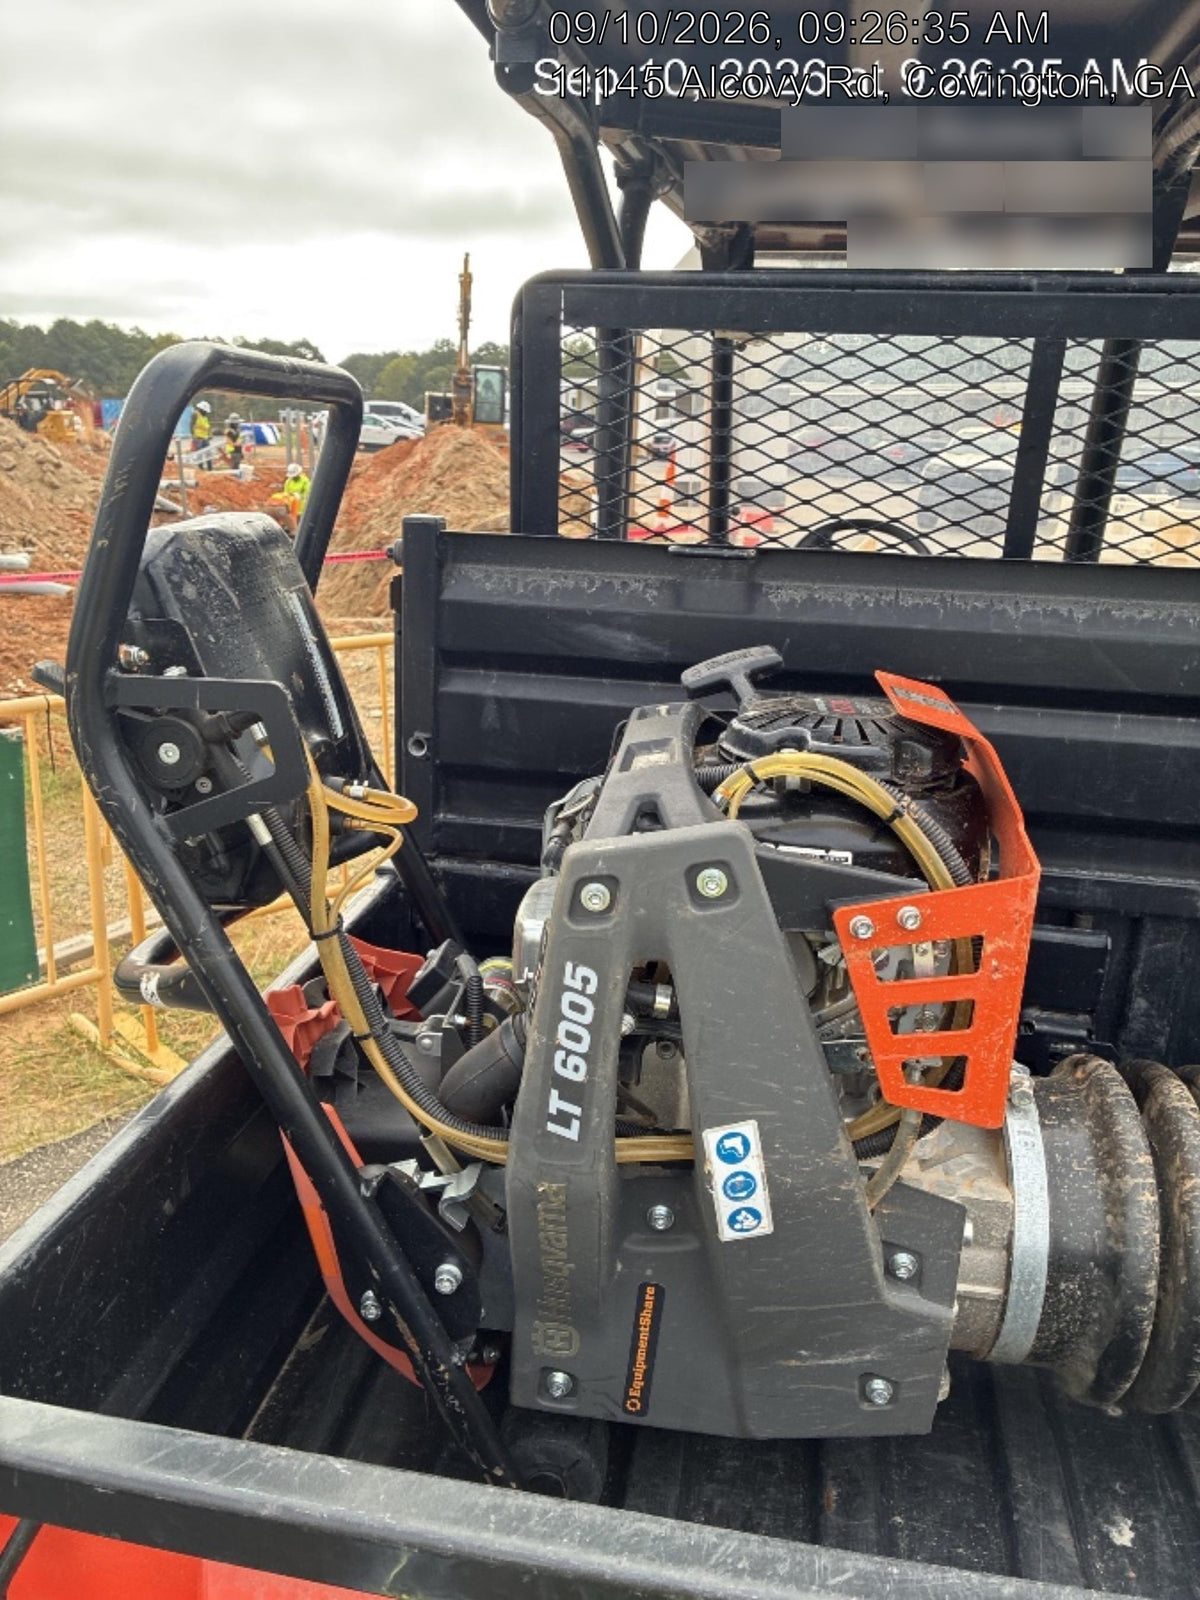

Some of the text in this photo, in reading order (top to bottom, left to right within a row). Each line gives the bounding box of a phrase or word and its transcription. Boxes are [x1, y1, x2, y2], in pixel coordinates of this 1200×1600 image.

[546, 960, 598, 1142] LT 6005
[628, 1285, 656, 1398] EquipmentShare
